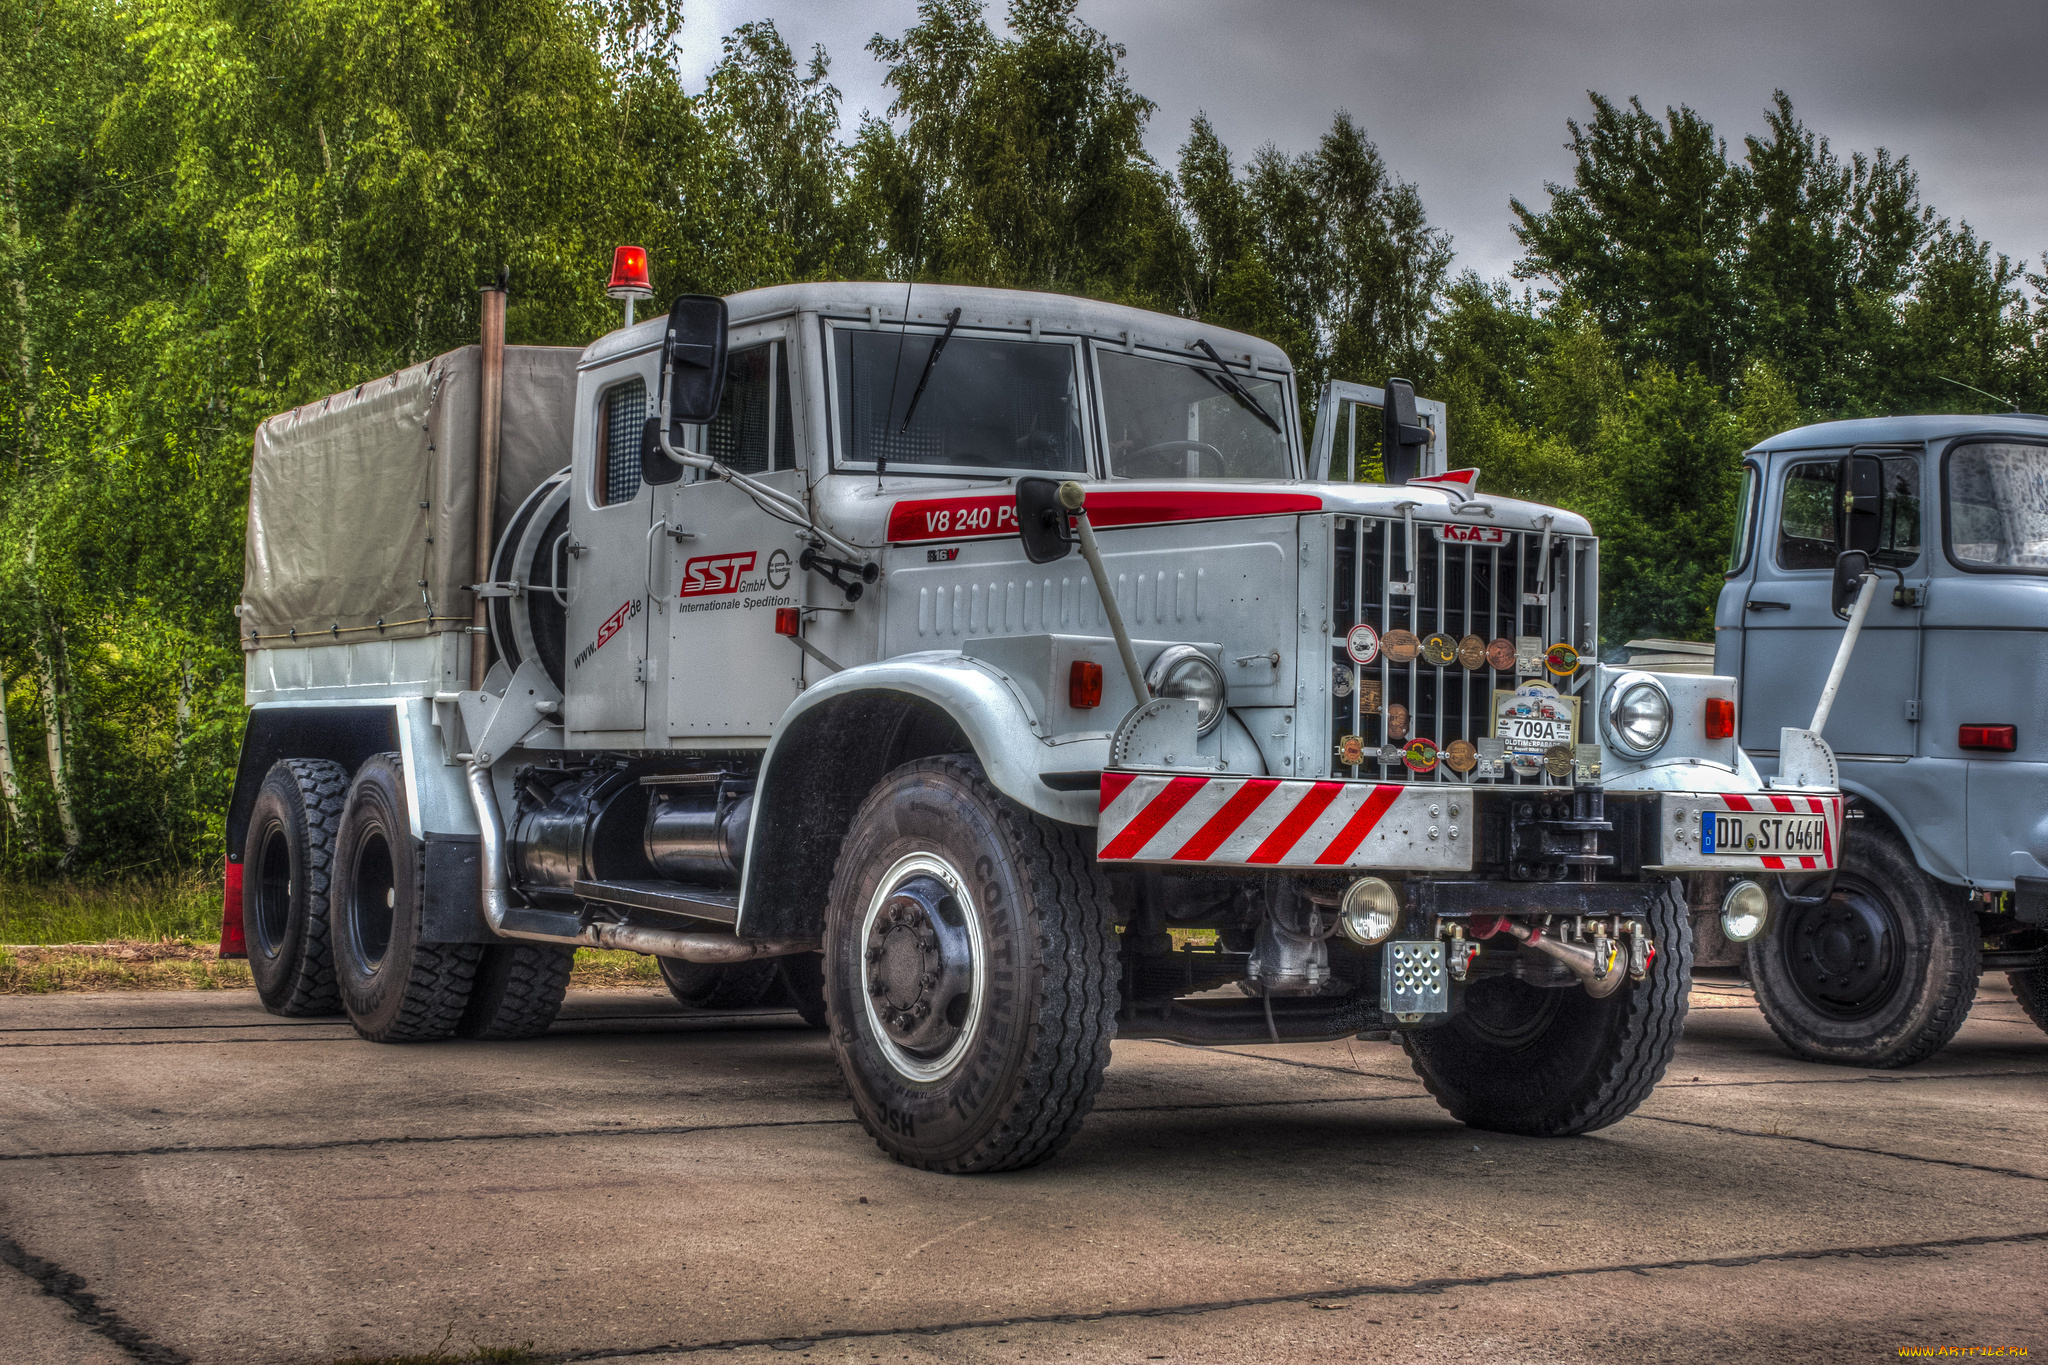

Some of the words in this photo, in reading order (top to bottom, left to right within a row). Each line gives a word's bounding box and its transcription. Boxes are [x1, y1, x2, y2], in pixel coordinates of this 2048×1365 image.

[926, 511, 950, 532] V8
[955, 507, 991, 530] 240
[935, 547, 959, 560] 16V
[684, 556, 753, 592] SST
[739, 579, 766, 593] GmbH
[679, 599, 740, 613] Internationale
[743, 597, 790, 610] Spedition
[1514, 720, 1555, 739] 709A
[1705, 837, 1711, 846] D
[1716, 817, 1743, 848] DD
[1759, 819, 1783, 849] ST
[1786, 820, 1823, 850] 646H
[877, 1101, 916, 1138] HSC
